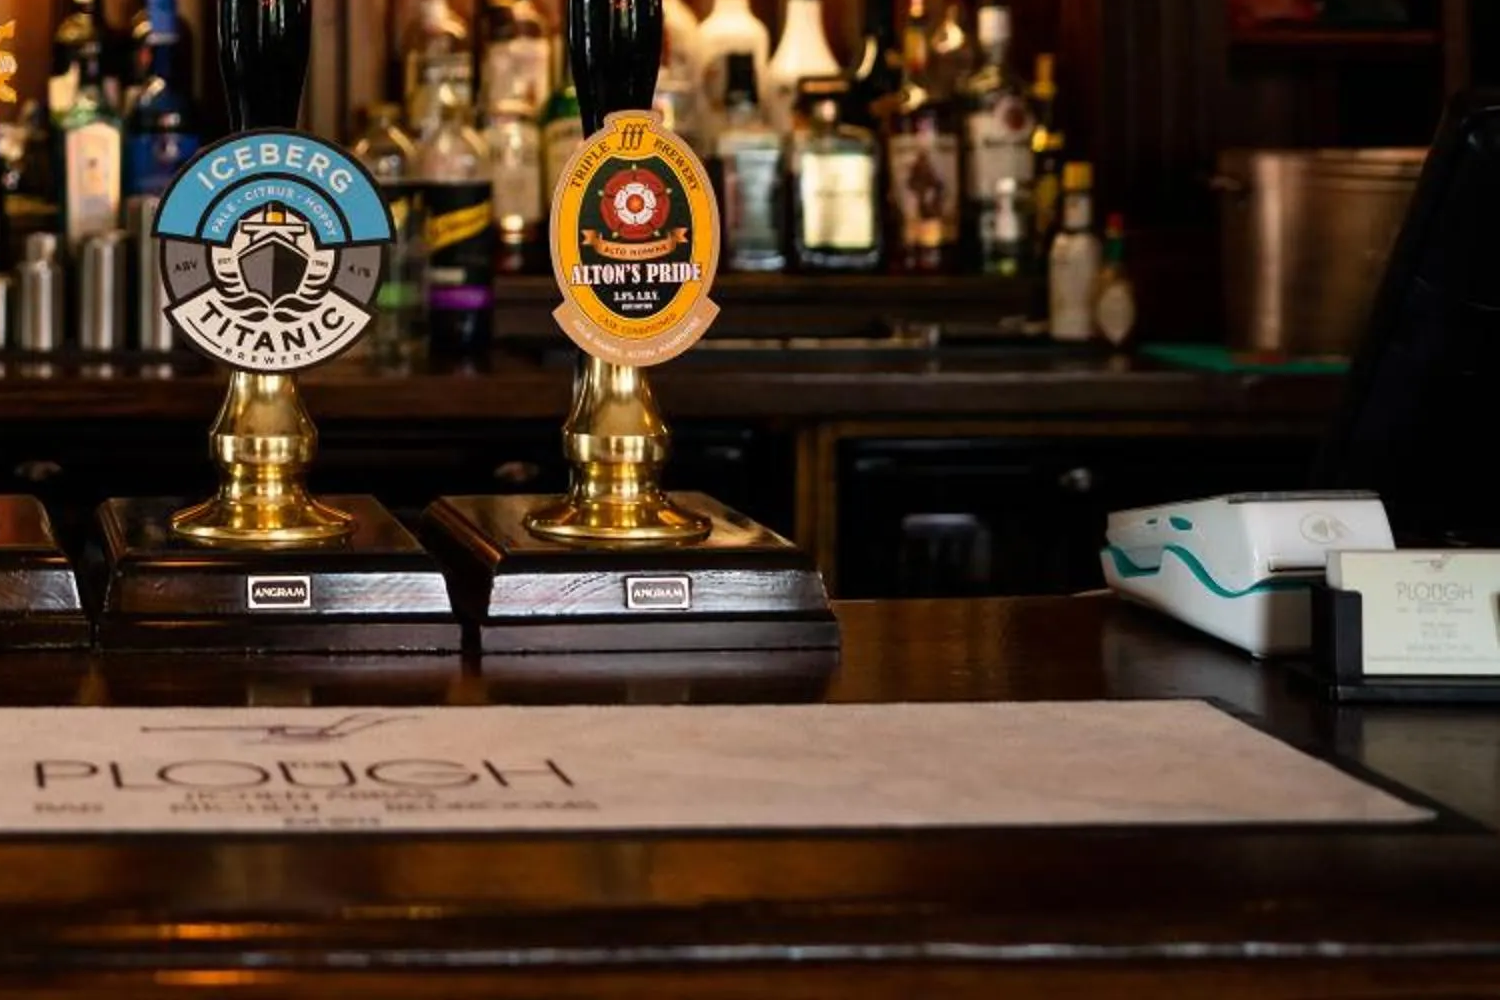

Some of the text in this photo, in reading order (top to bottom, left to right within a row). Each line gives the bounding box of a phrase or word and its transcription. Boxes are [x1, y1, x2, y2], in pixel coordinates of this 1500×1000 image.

[197, 143, 353, 194] ICEBERG
[570, 141, 611, 187] TRIPLE
[653, 137, 698, 189] BREWERY
[212, 203, 238, 233] PALE
[571, 262, 702, 285] ALTON'S PRIDE
[200, 301, 345, 353] TITANIC
[224, 348, 315, 366] BREWERY
[1394, 580, 1474, 601] PLOUGH
[34, 757, 575, 790] PLOUGH
